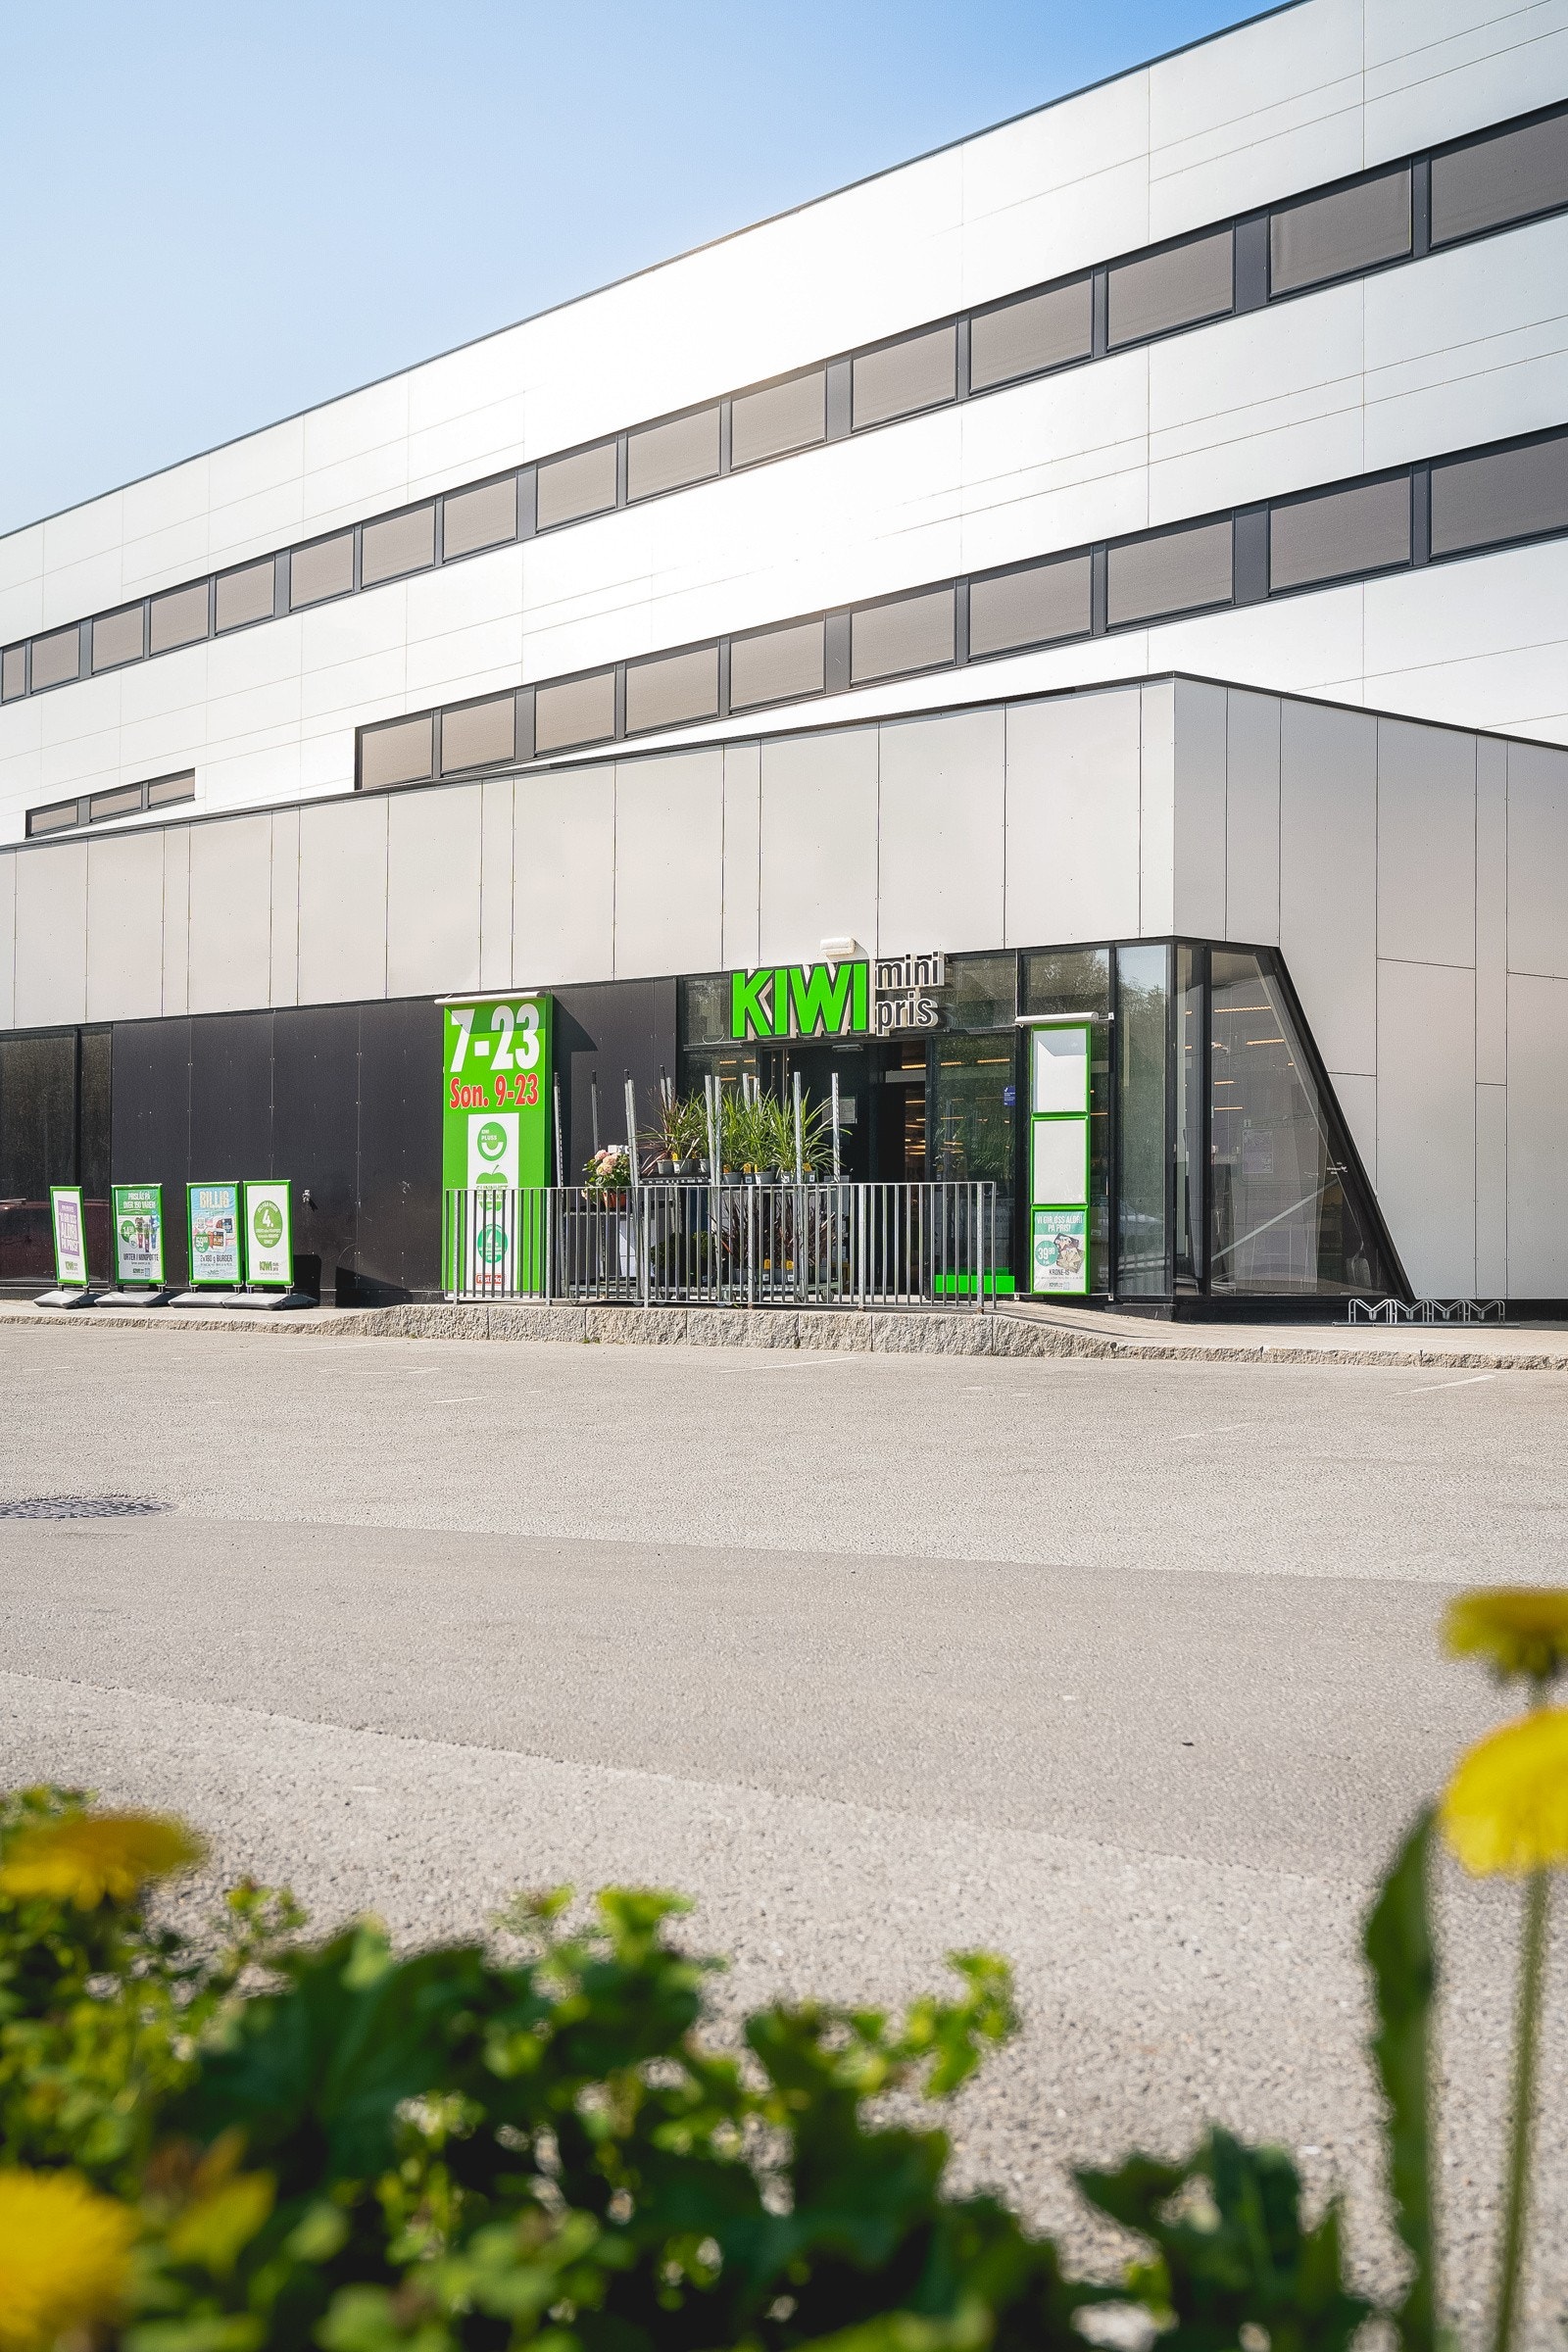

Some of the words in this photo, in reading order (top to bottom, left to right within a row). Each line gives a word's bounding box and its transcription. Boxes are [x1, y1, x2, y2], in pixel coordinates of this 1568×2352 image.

[875, 951, 943, 990] mini
[730, 959, 870, 1040] KIWI
[875, 991, 937, 1037] pris
[450, 1003, 540, 1073] 7-23
[494, 1073, 539, 1106] 9-23
[262, 1208, 274, 1227] 4.
